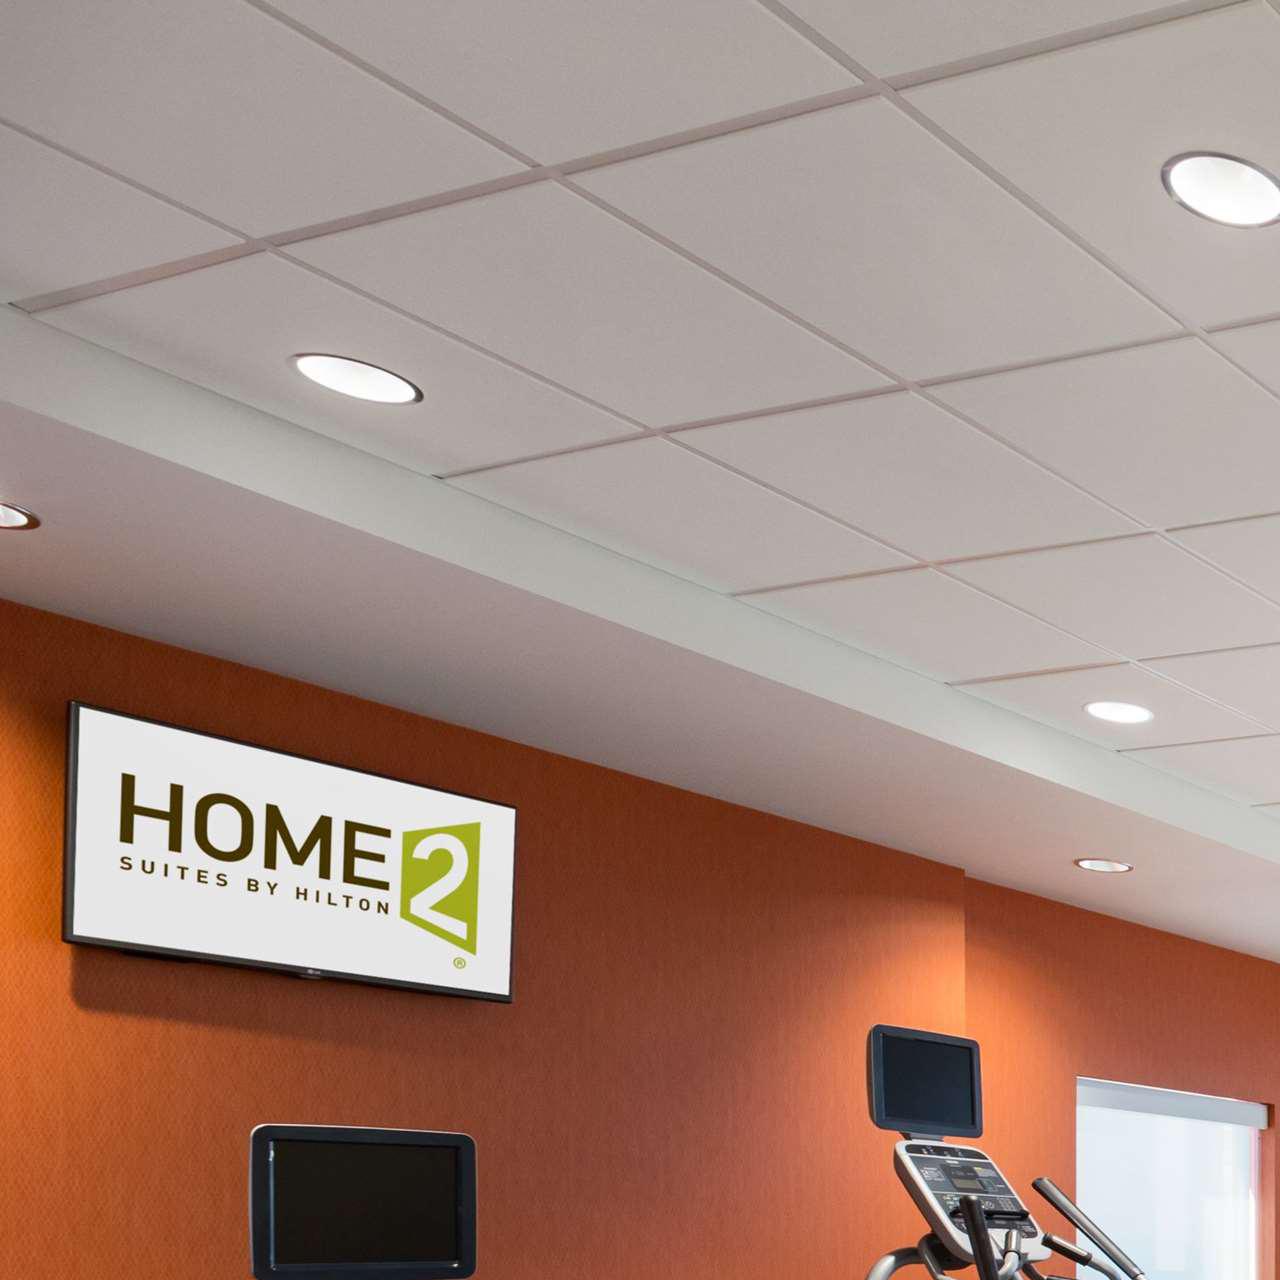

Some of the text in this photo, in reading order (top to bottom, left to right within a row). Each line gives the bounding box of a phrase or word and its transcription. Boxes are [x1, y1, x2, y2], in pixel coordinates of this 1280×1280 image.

[119, 773, 392, 891] HOME
[120, 855, 390, 915] SUITES BY HILTON
